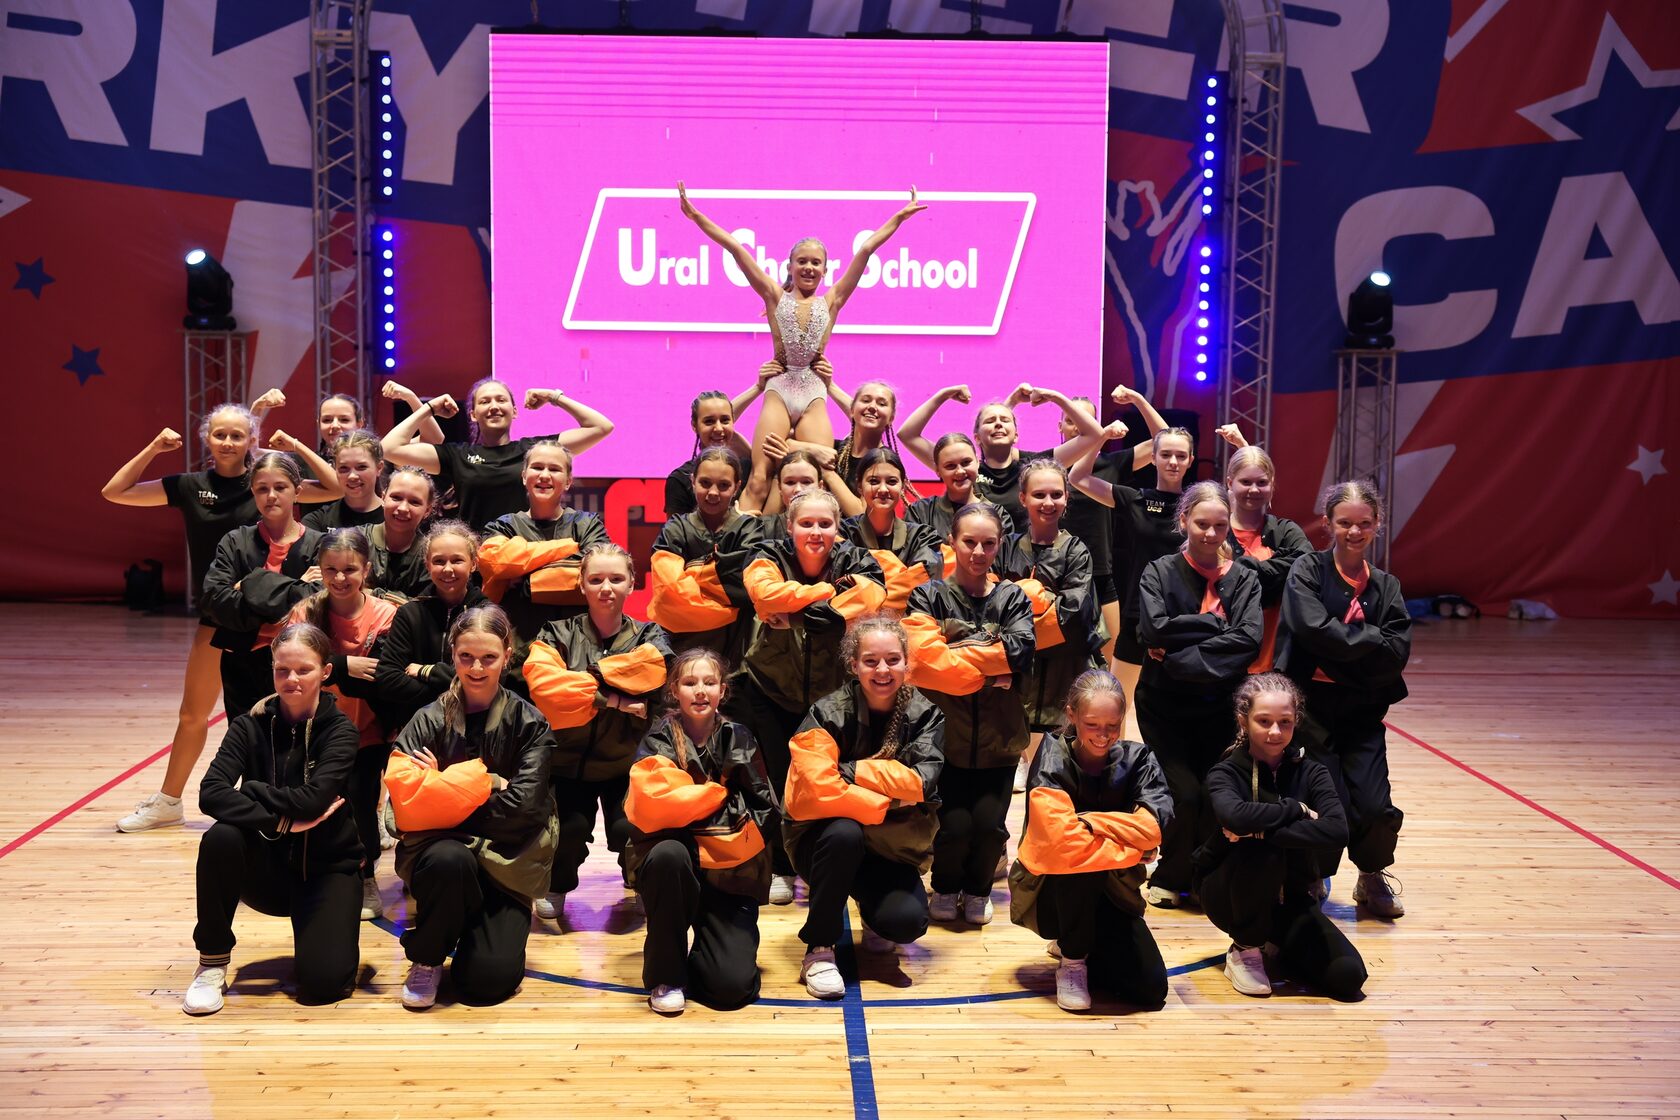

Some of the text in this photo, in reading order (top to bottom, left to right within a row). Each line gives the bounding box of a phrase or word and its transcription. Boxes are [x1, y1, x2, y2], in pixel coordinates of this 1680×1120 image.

[618, 228, 978, 288] Ural Chr School
[1335, 171, 1680, 353] CA
[1146, 500, 1165, 508] TEAM
